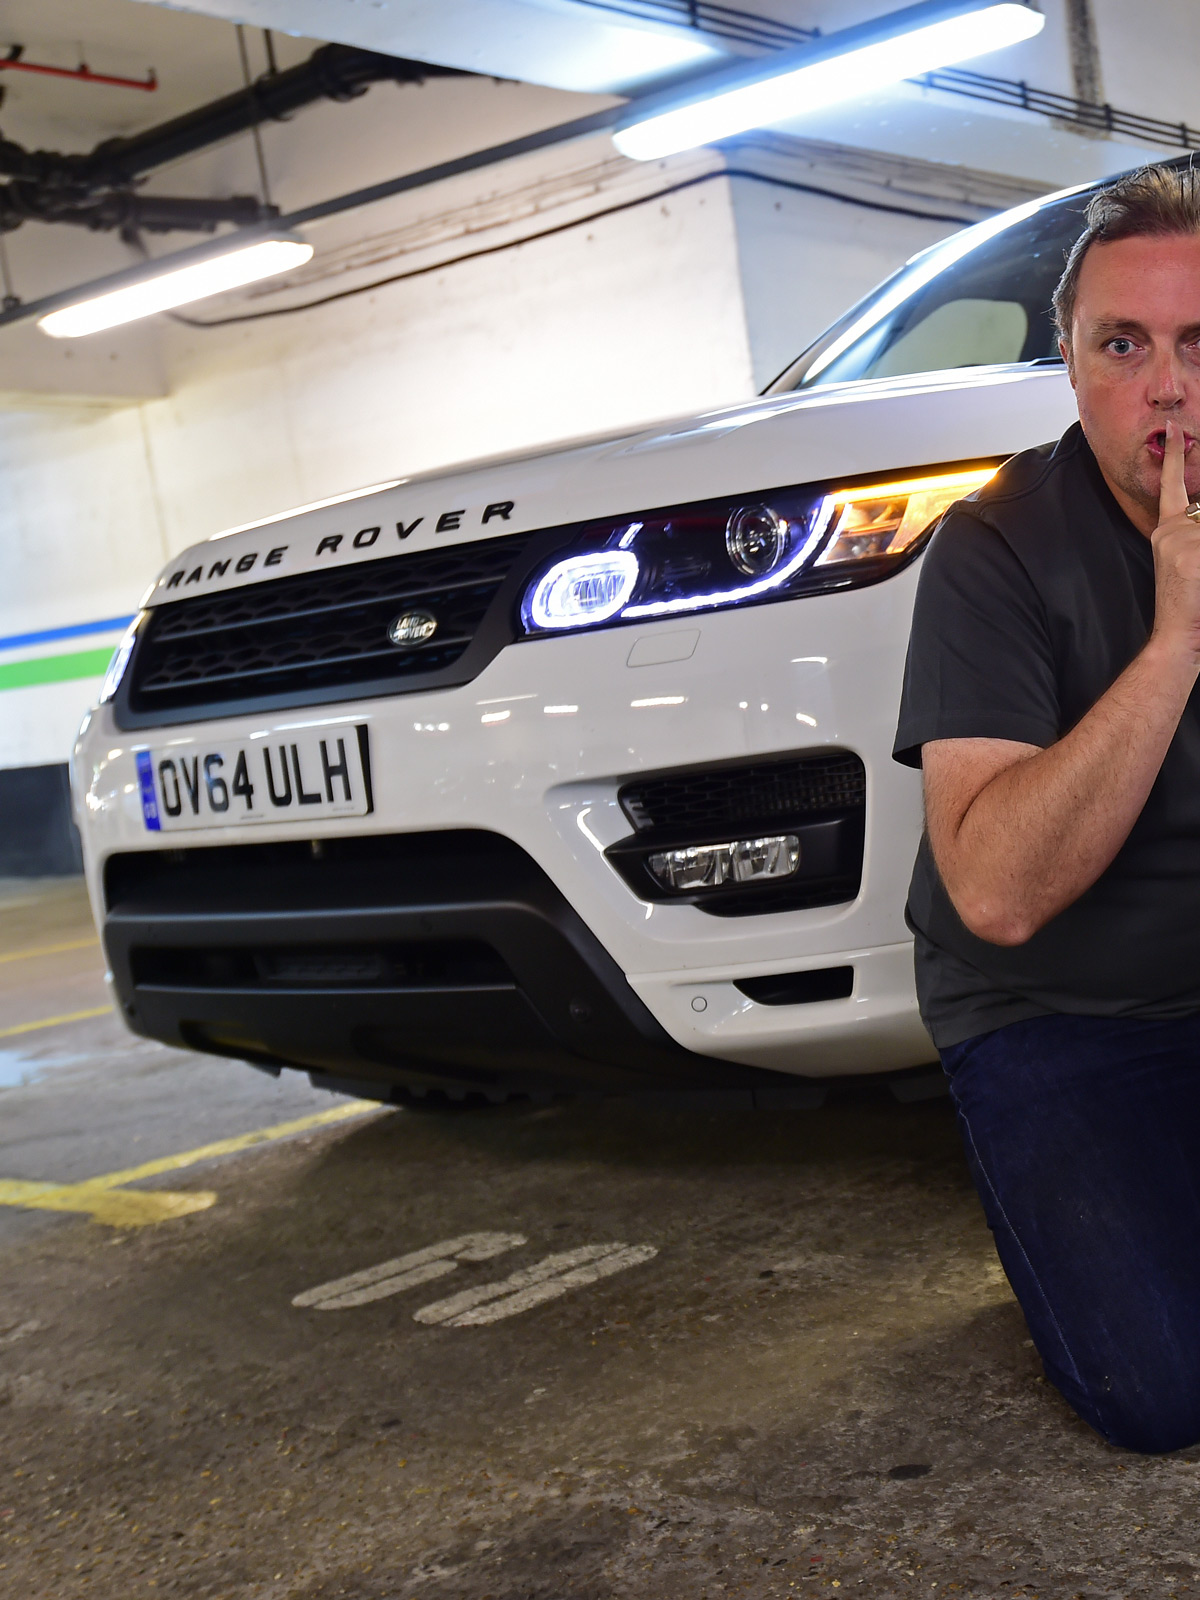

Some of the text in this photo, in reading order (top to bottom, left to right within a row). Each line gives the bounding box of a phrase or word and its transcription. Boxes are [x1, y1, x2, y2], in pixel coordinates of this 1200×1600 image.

[166, 501, 515, 590] RANGE ROVER
[397, 617, 420, 631] LAND
[158, 738, 352, 817] OV64 ULH
